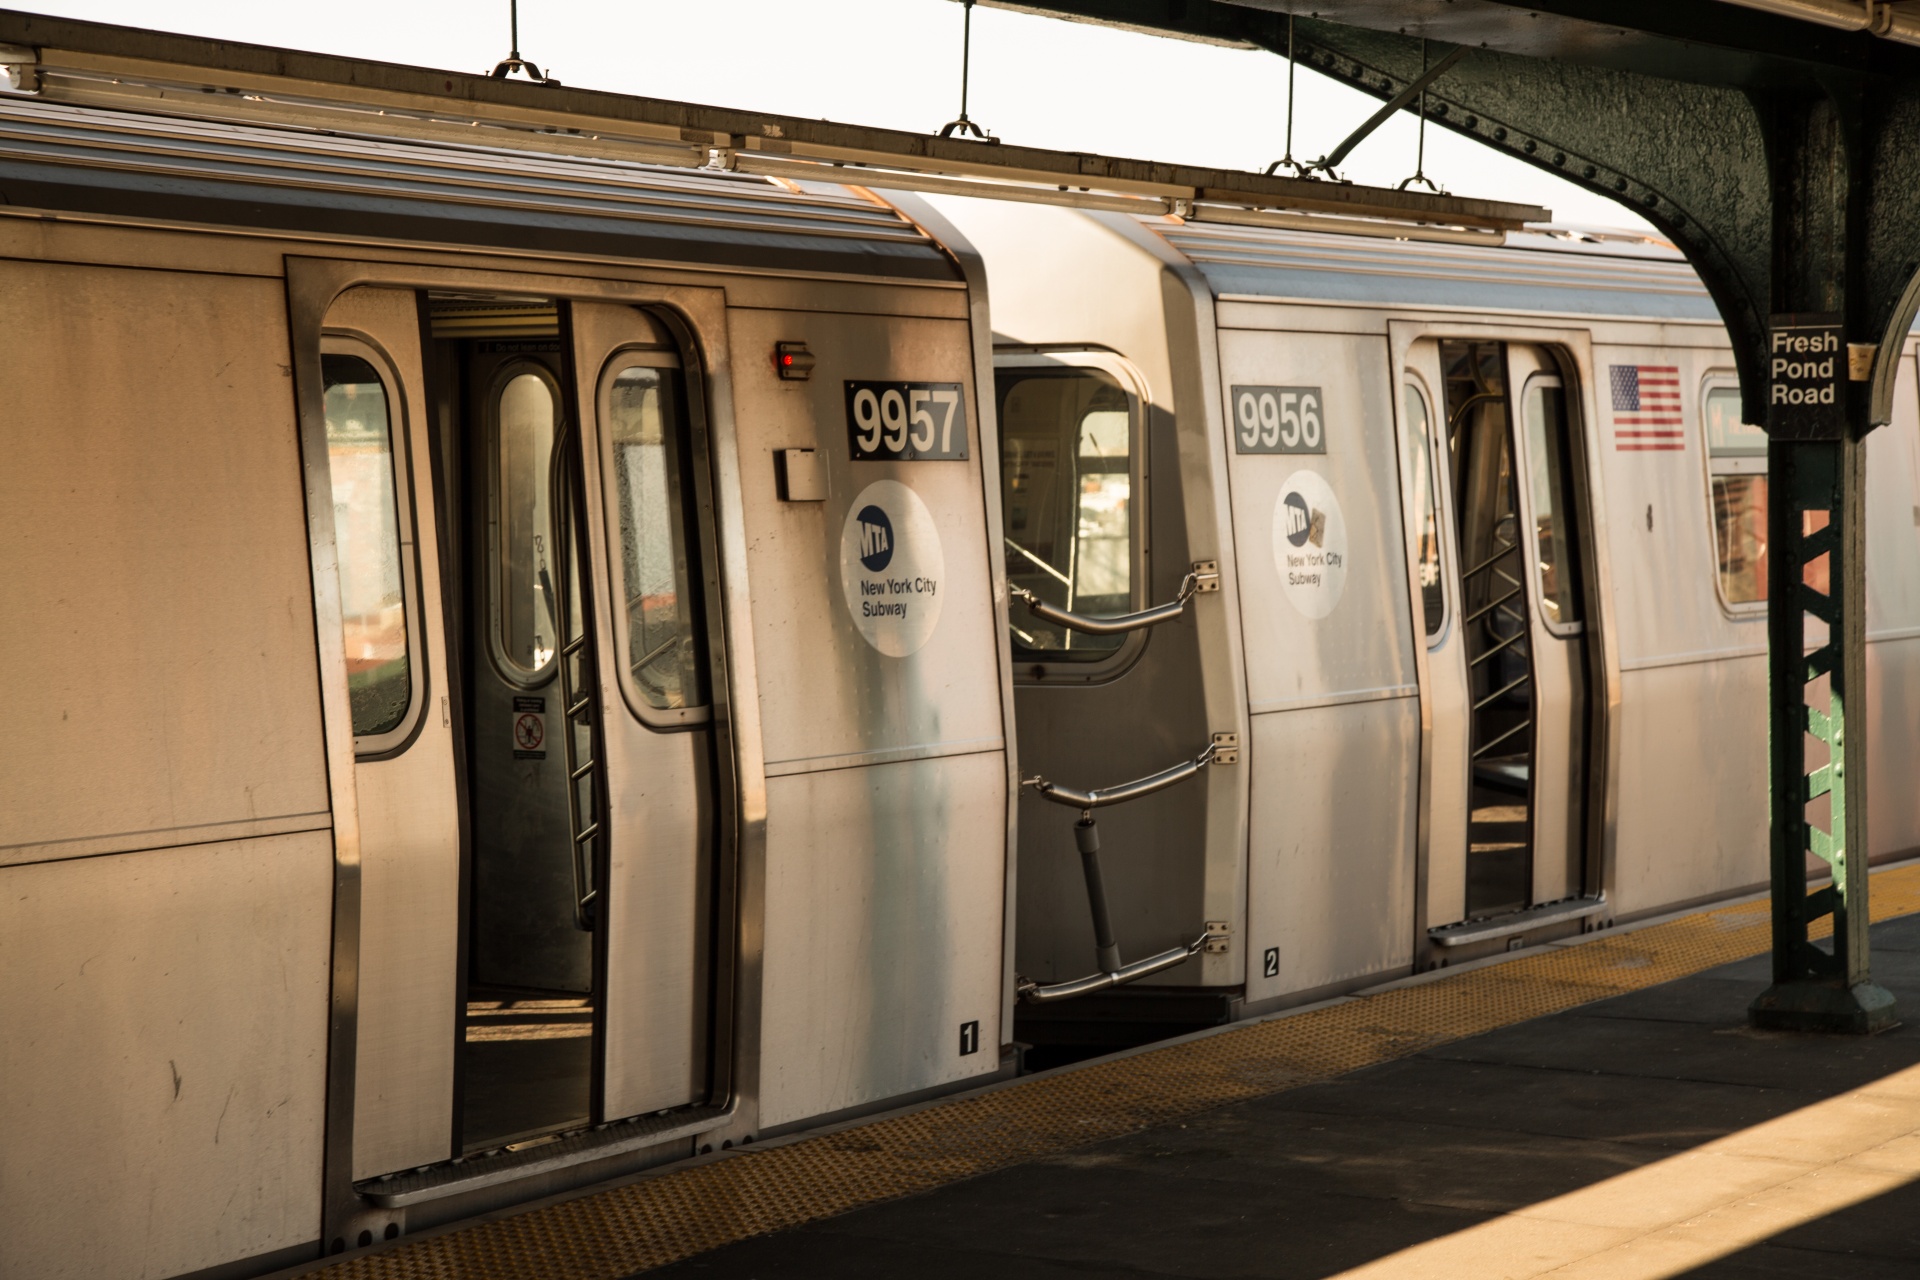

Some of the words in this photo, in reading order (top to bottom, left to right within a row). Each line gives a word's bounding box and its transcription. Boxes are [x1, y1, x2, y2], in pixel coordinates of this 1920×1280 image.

[496, 343, 506, 352] Do
[507, 342, 519, 352] not
[520, 342, 536, 352] lean
[537, 344, 548, 352] on
[1772, 331, 1838, 353] Fresh
[1772, 357, 1834, 379] Pond
[1771, 383, 1835, 405] Road
[854, 388, 959, 453] 9957
[1238, 392, 1321, 448] 9956
[1285, 503, 1308, 537] MTA
[859, 520, 889, 558] MTA
[1287, 554, 1305, 568] New
[1306, 552, 1325, 567] York
[1326, 551, 1342, 568] City
[861, 579, 885, 596] New
[887, 578, 912, 594] York
[915, 577, 936, 596] City
[1288, 571, 1321, 587] Subway
[862, 600, 907, 619] Subway
[1267, 950, 1277, 976] 2
[964, 1024, 973, 1053] 1
